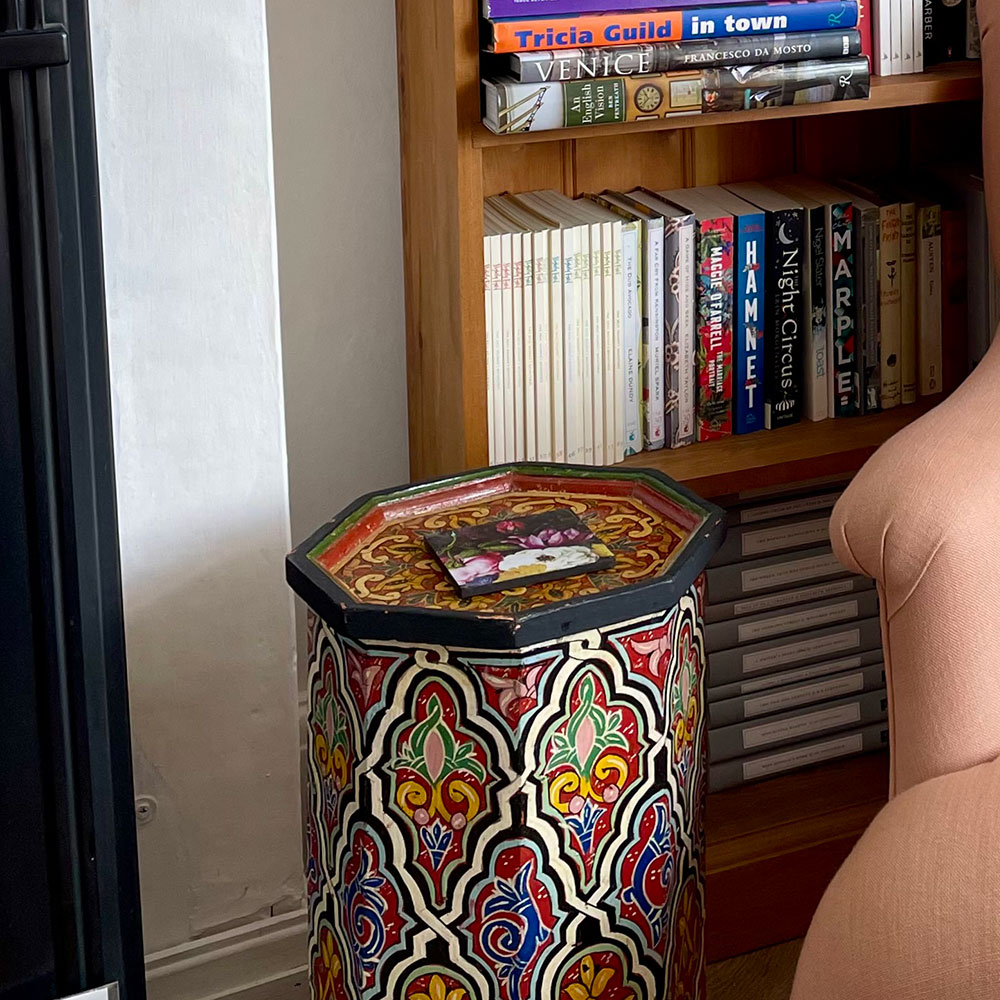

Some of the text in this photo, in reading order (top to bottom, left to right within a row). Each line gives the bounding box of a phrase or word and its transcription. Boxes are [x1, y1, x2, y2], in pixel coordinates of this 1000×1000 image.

[515, 21, 671, 48] Tricia Guild
[691, 14, 787, 35] in town
[534, 44, 811, 81] VENICE FRANCESCO DA MOSTO
[571, 97, 581, 113] An
[582, 84, 591, 124] English
[595, 85, 604, 119] Vision
[813, 227, 824, 287] Nigel Slater
[710, 247, 723, 350] MAGGIE O'FARRELL
[834, 229, 853, 393] MARPLE
[744, 241, 758, 408] HAMNET
[778, 250, 800, 389] Night Circus
[816, 347, 825, 378] Toast
